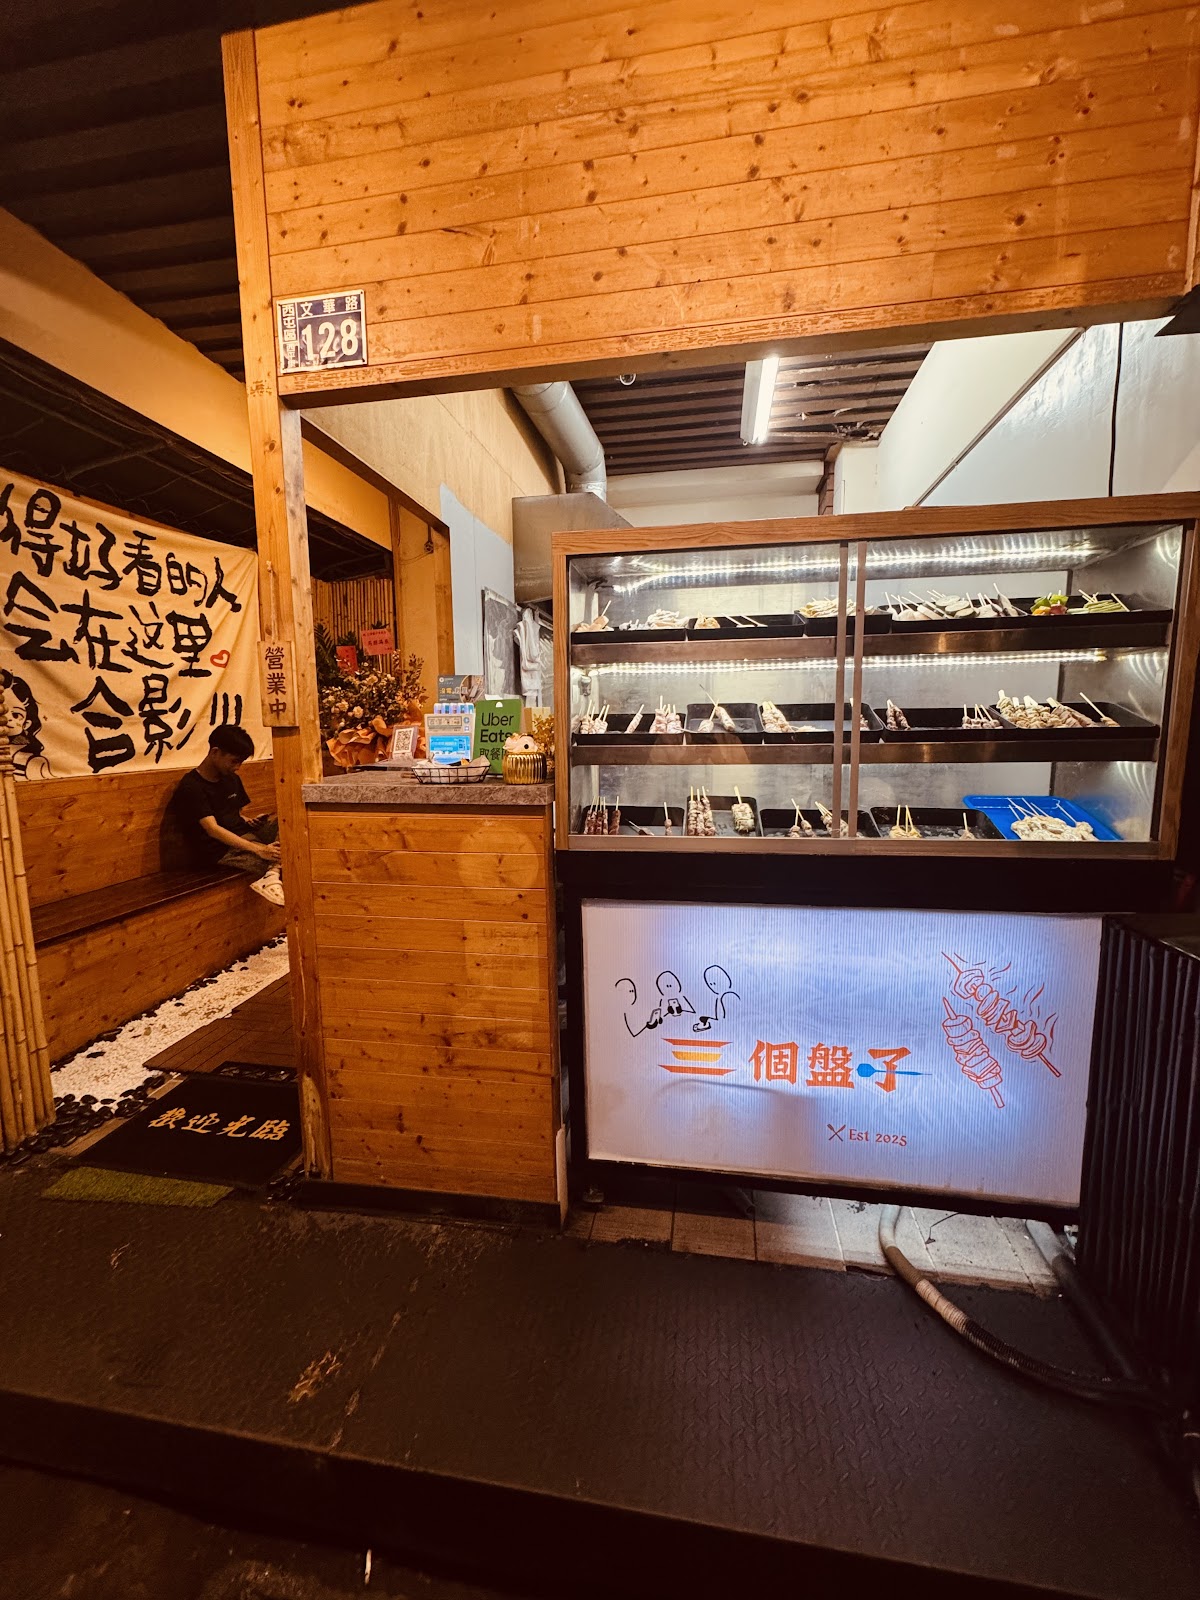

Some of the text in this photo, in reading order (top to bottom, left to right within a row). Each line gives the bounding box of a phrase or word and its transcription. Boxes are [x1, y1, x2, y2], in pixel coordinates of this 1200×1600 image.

[282, 304, 297, 341] 西屯區
[300, 295, 358, 317] 文華路
[302, 318, 358, 361] 128
[3, 571, 213, 678] 会在这里
[265, 646, 287, 720] 營業中
[481, 712, 514, 726] Uber
[479, 747, 505, 760] 取餐
[658, 1037, 920, 1093] 三個盤子
[849, 1128, 907, 1147] Est 2025
